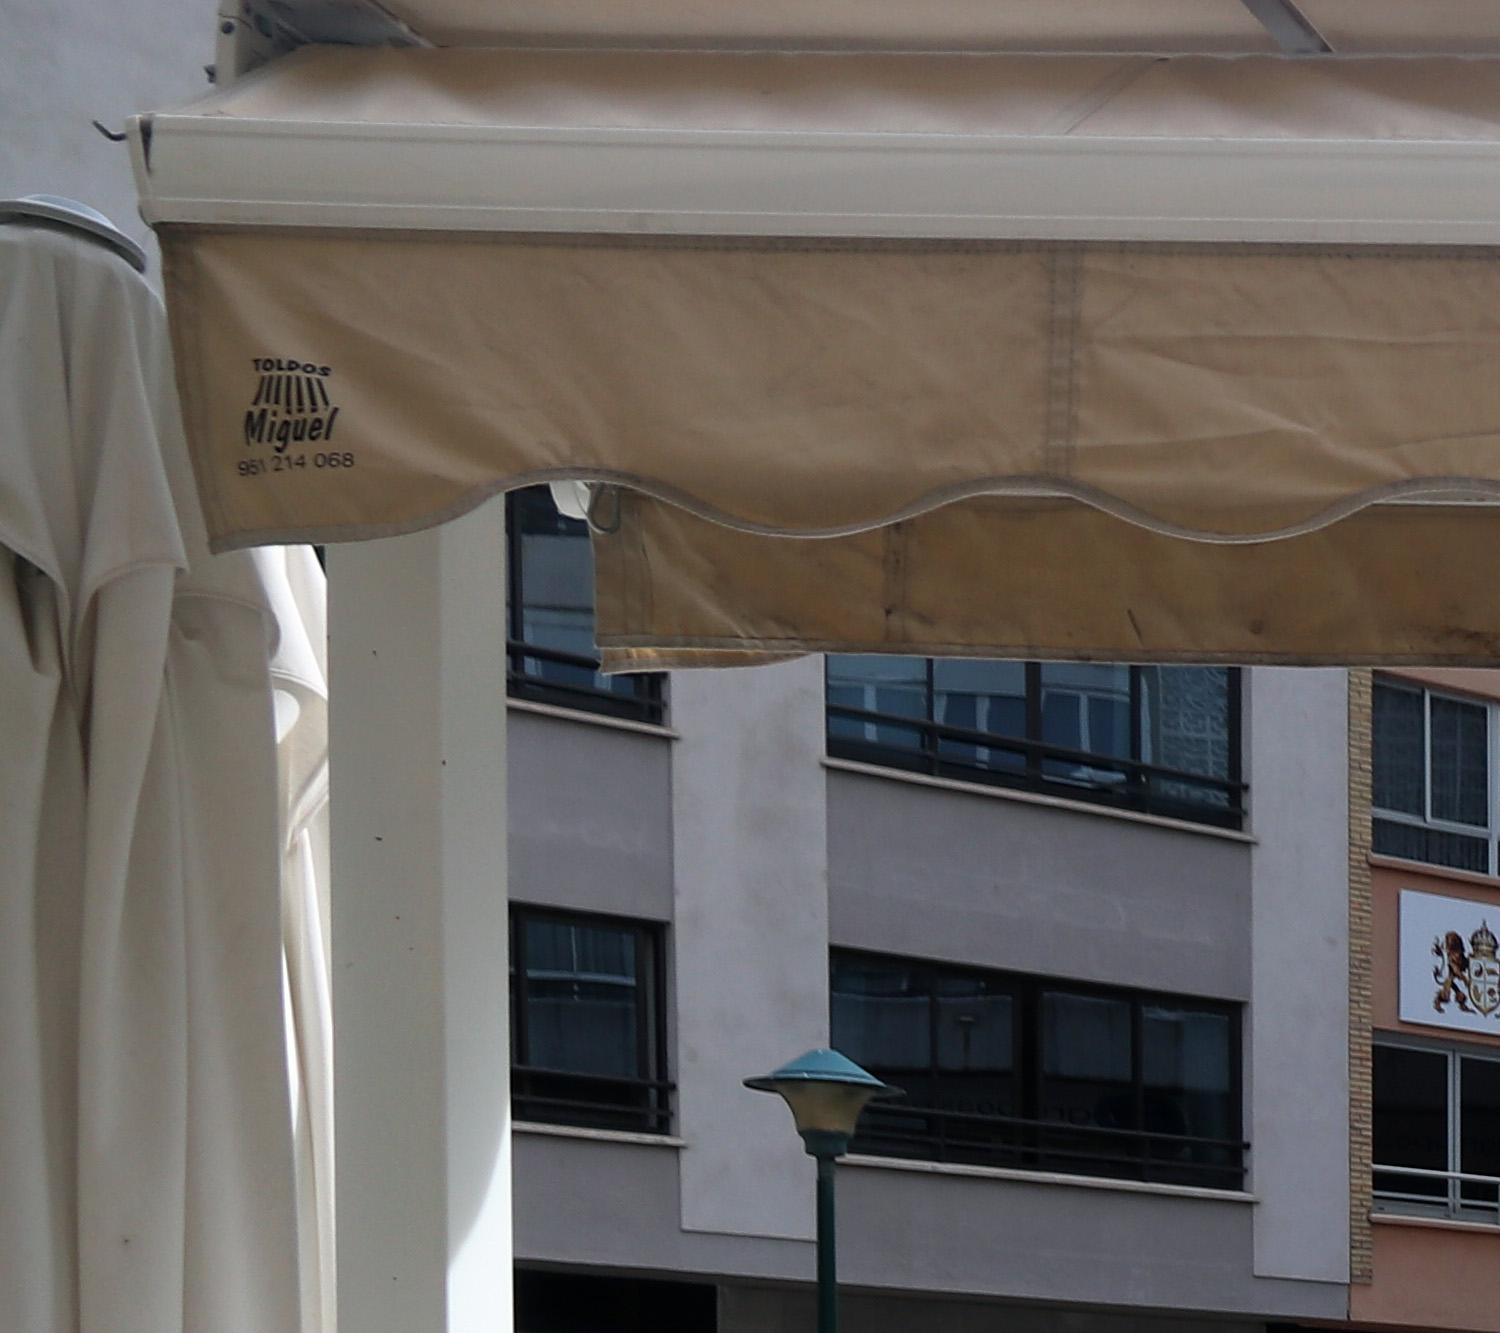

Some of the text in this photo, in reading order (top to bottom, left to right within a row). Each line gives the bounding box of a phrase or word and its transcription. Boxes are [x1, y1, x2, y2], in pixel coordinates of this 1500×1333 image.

[252, 358, 332, 377] TOLDOS
[244, 406, 340, 454] Miguel
[238, 452, 355, 476] 951 214 068
